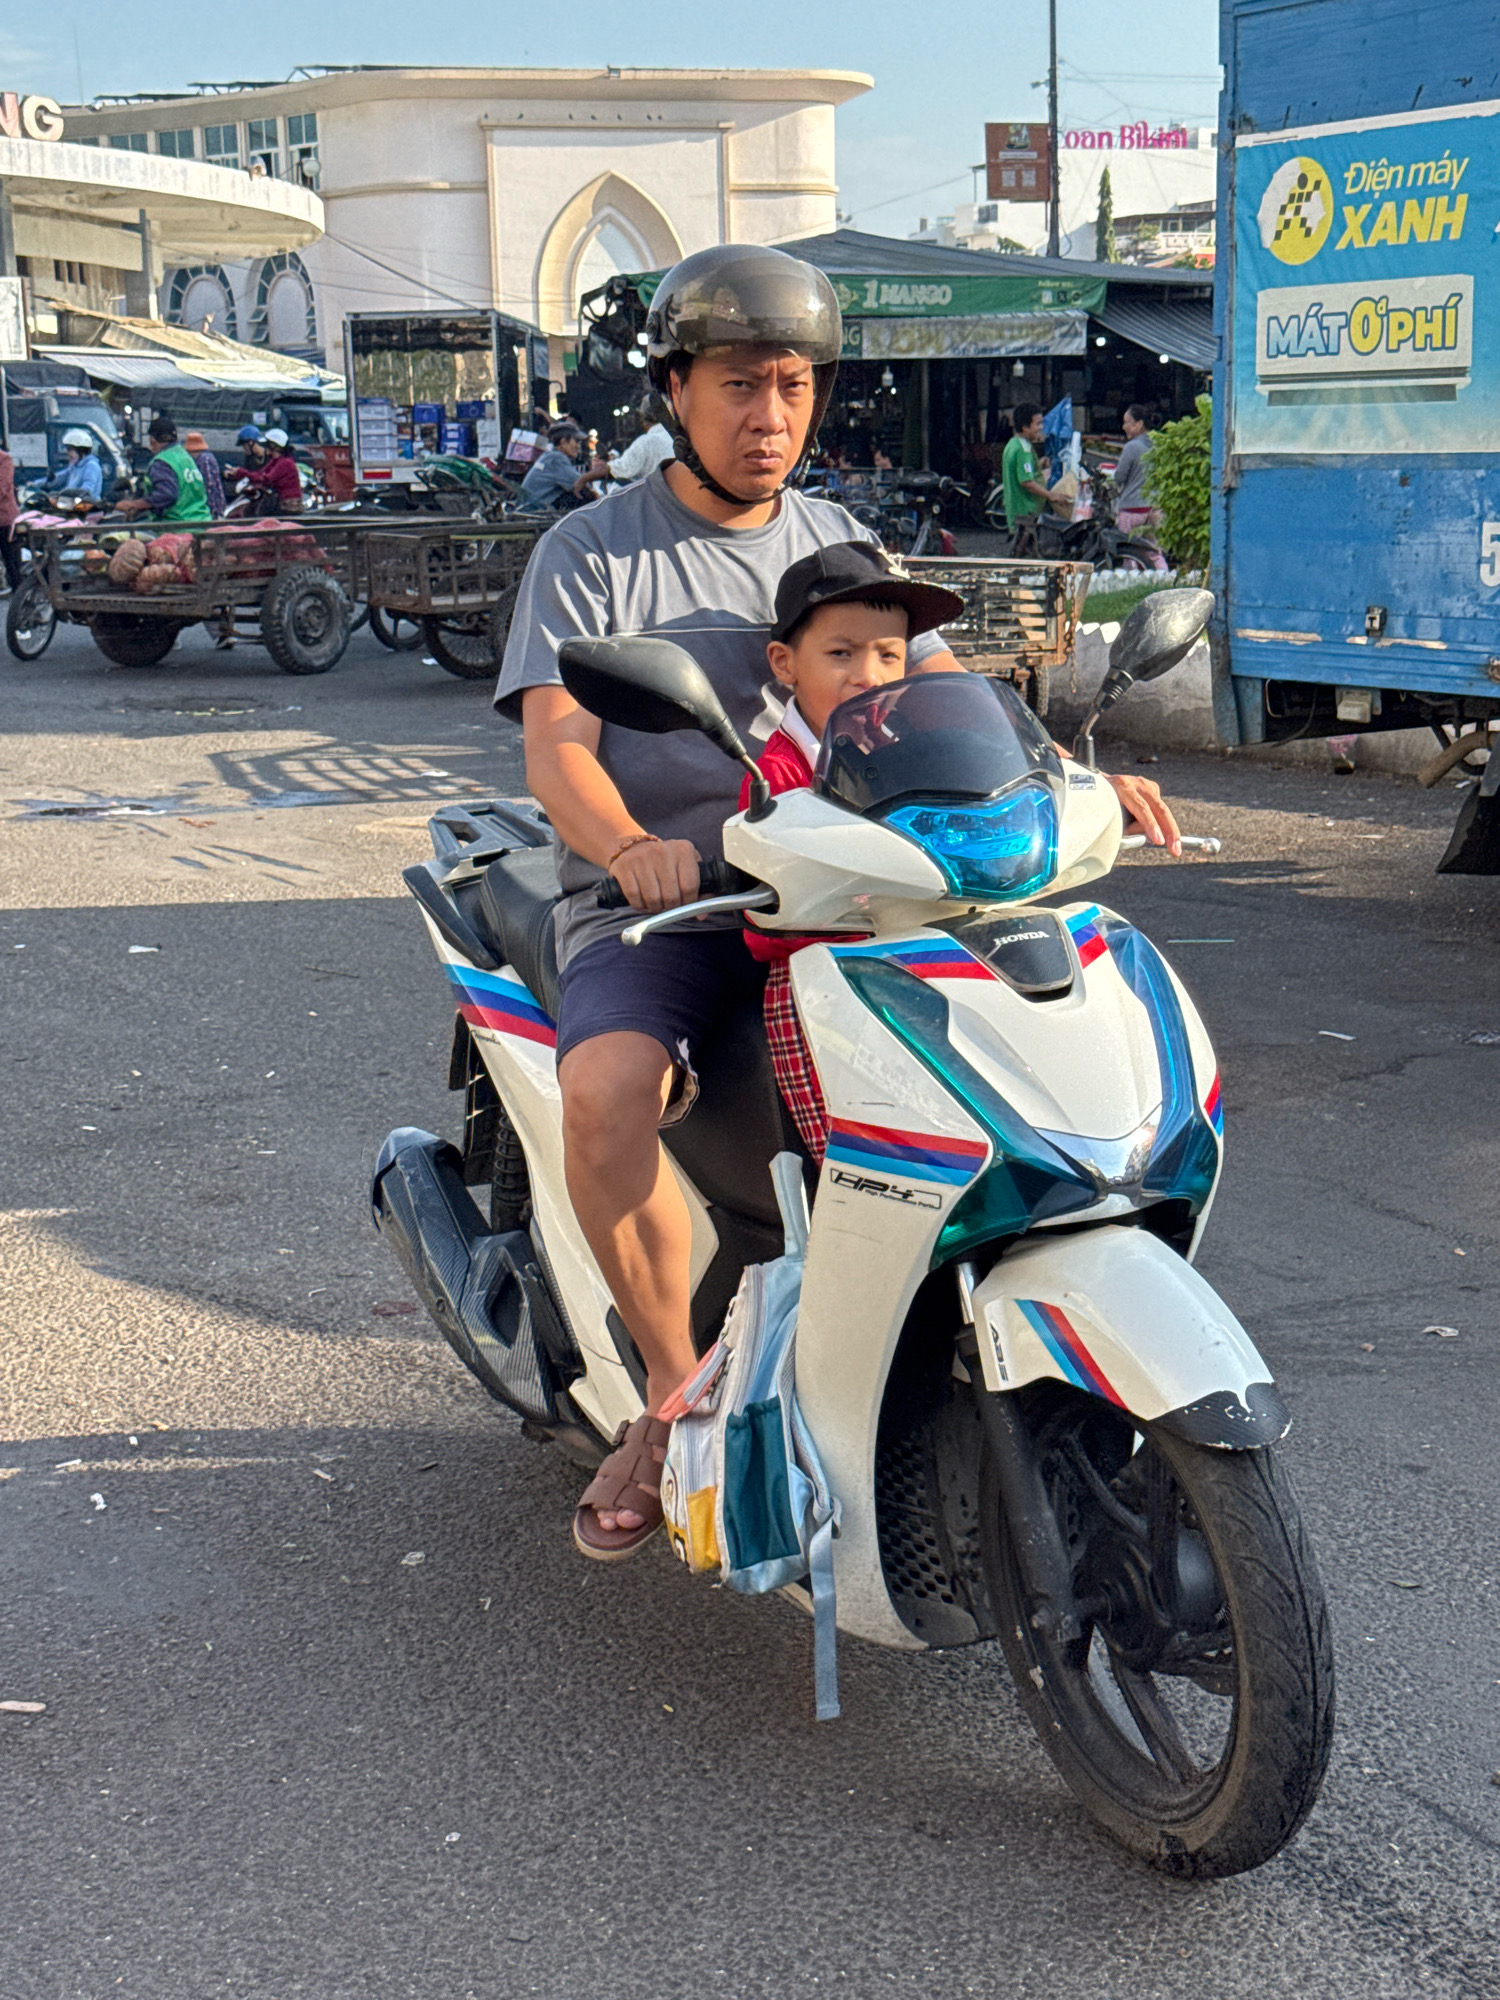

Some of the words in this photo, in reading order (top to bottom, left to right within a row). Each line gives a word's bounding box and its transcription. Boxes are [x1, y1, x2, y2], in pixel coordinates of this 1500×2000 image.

[1058, 131, 1113, 149] oan
[1344, 157, 1404, 199] Điện
[1406, 149, 1469, 190] máy
[1335, 193, 1469, 250] XANH
[879, 284, 953, 306] MANGO
[1266, 302, 1348, 359] MÁT
[1386, 292, 1463, 353] PHÍ
[1480, 521, 1500, 587] 5
[993, 931, 1050, 945] HONDA
[834, 1171, 915, 1199] HP4
